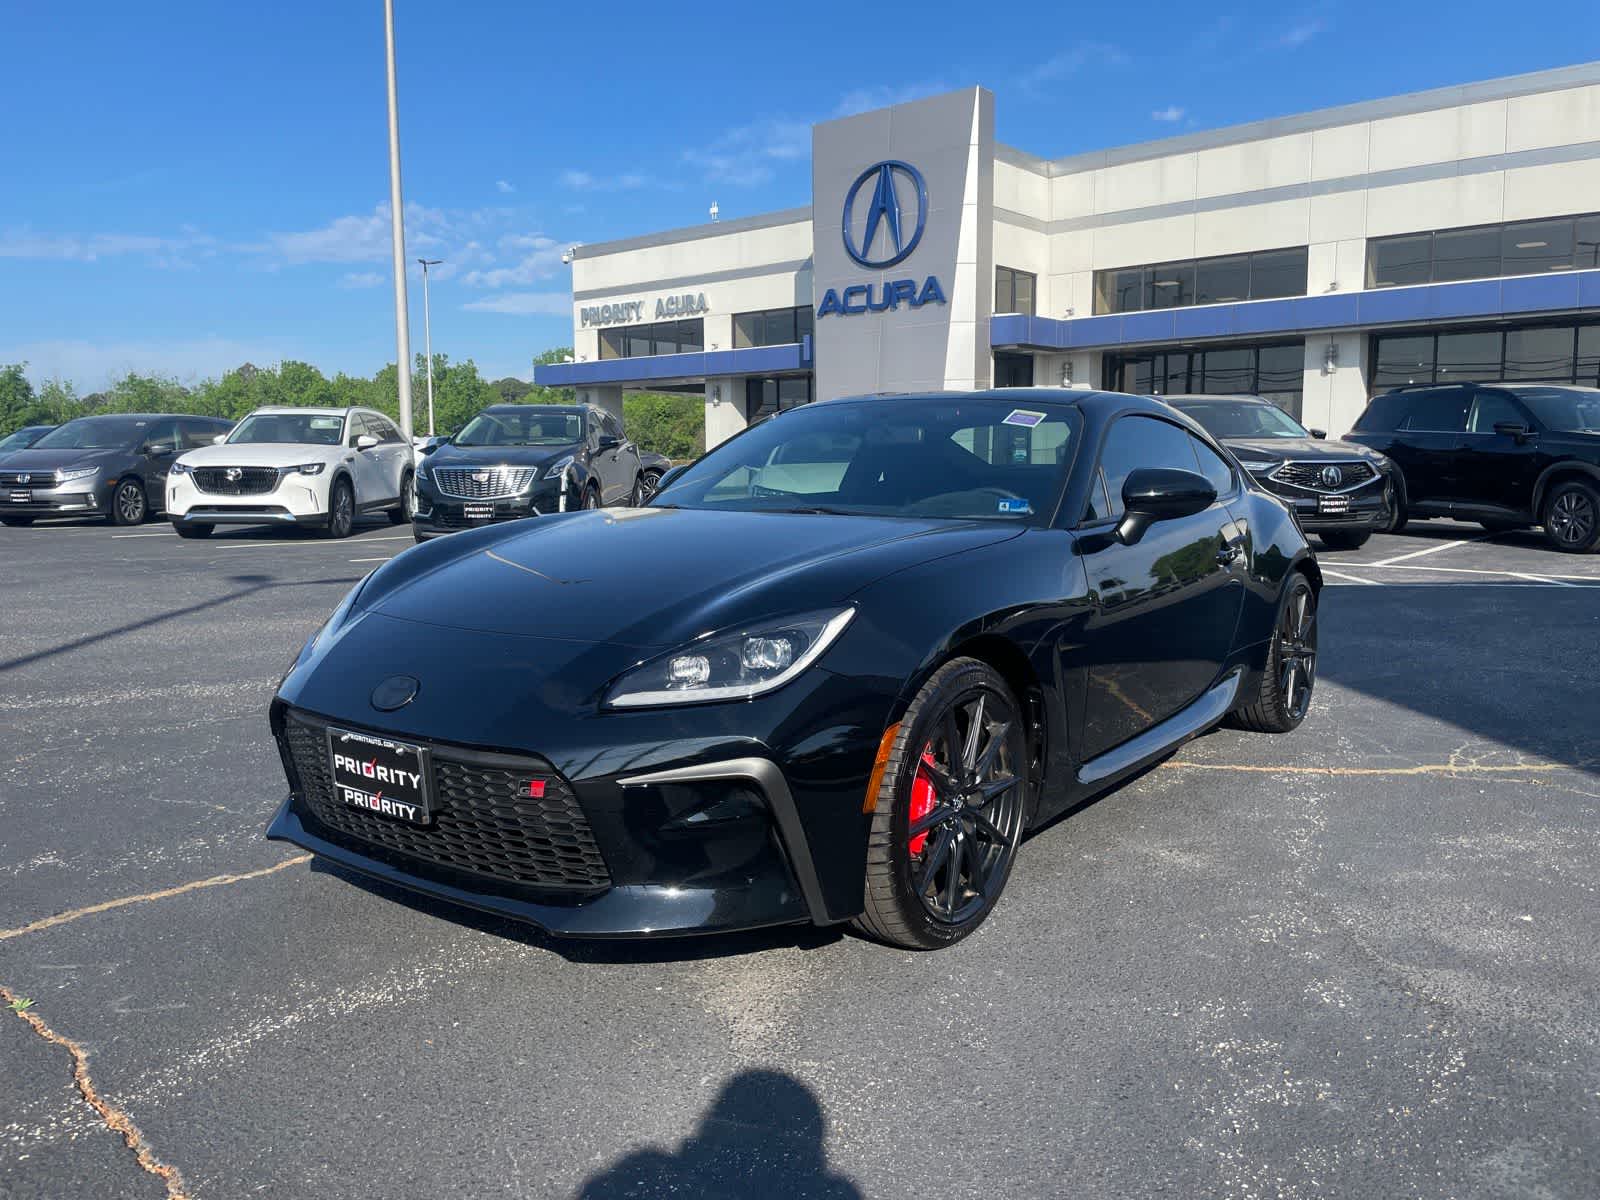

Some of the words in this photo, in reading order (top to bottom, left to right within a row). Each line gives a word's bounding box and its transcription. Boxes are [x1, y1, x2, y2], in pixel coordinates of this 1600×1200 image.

[580, 300, 645, 328] PRIORITY
[655, 292, 709, 320] ACURA
[816, 275, 947, 320] ACURA
[334, 754, 421, 789] PRIORITY
[344, 789, 416, 820] PRIORITY
